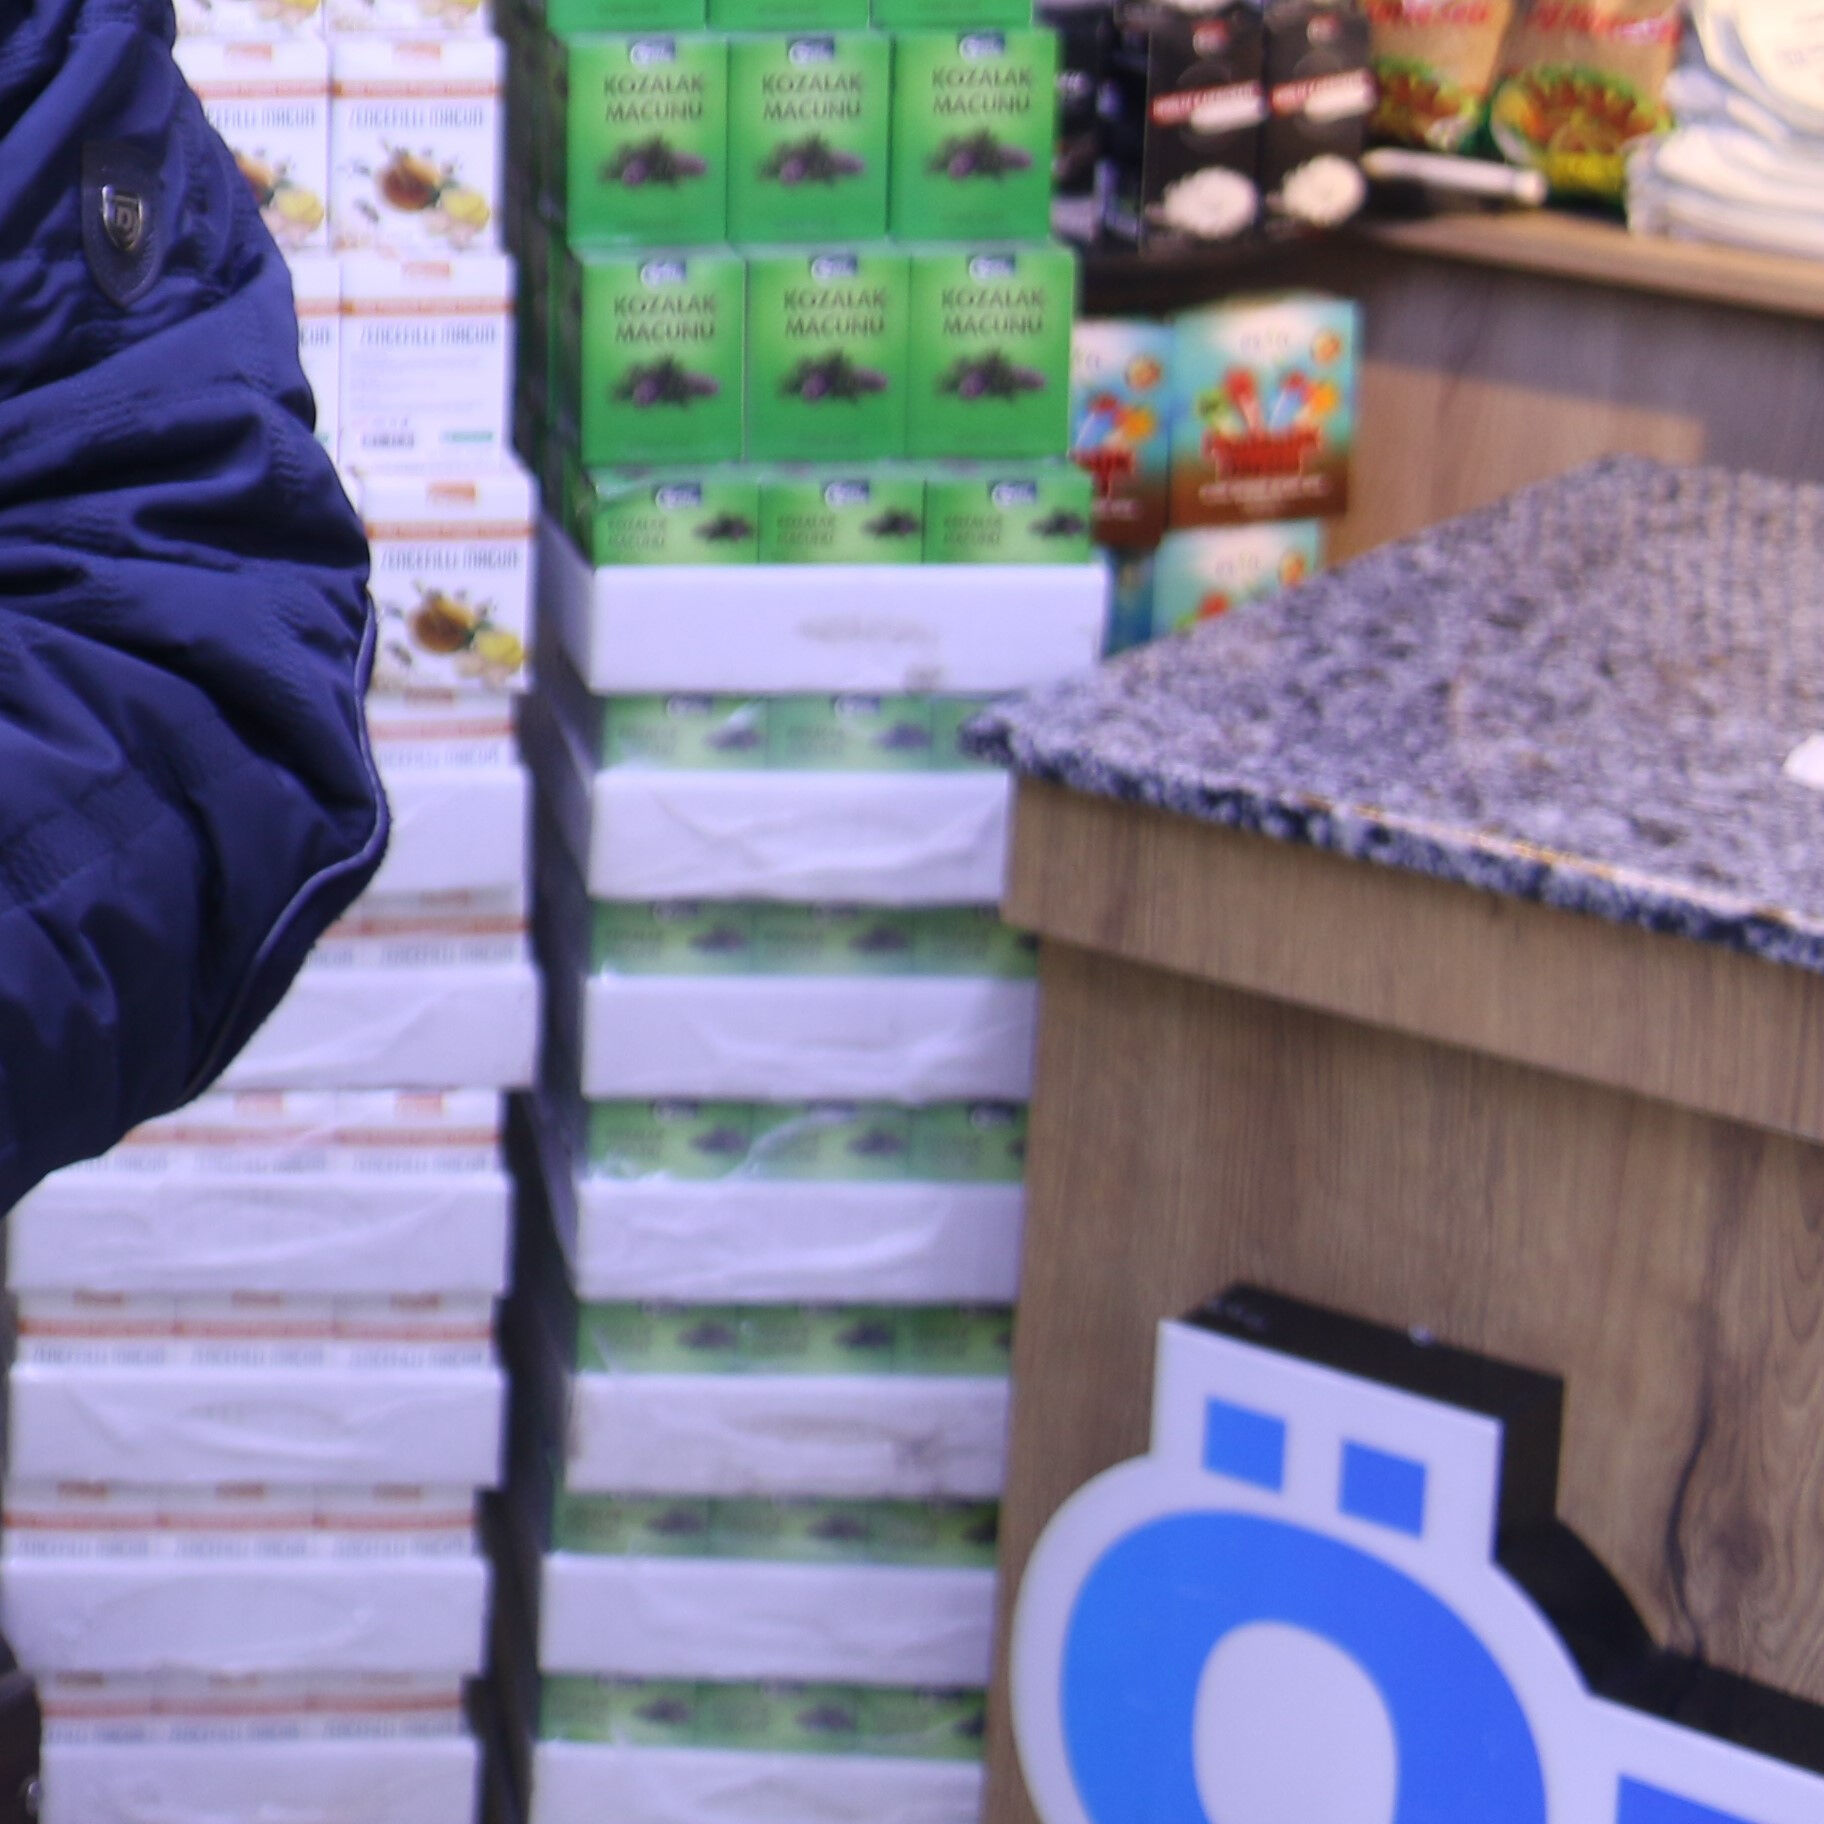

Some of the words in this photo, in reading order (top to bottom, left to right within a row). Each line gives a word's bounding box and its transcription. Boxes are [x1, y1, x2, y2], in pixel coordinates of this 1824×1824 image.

[602, 72, 704, 98] KOZALAK
[761, 71, 863, 97] KOZALAK
[930, 66, 1034, 91] KOZALAK
[612, 292, 717, 320] KOZALAK
[782, 287, 888, 315] KOZALAK
[940, 287, 1046, 315] KOZALAK
